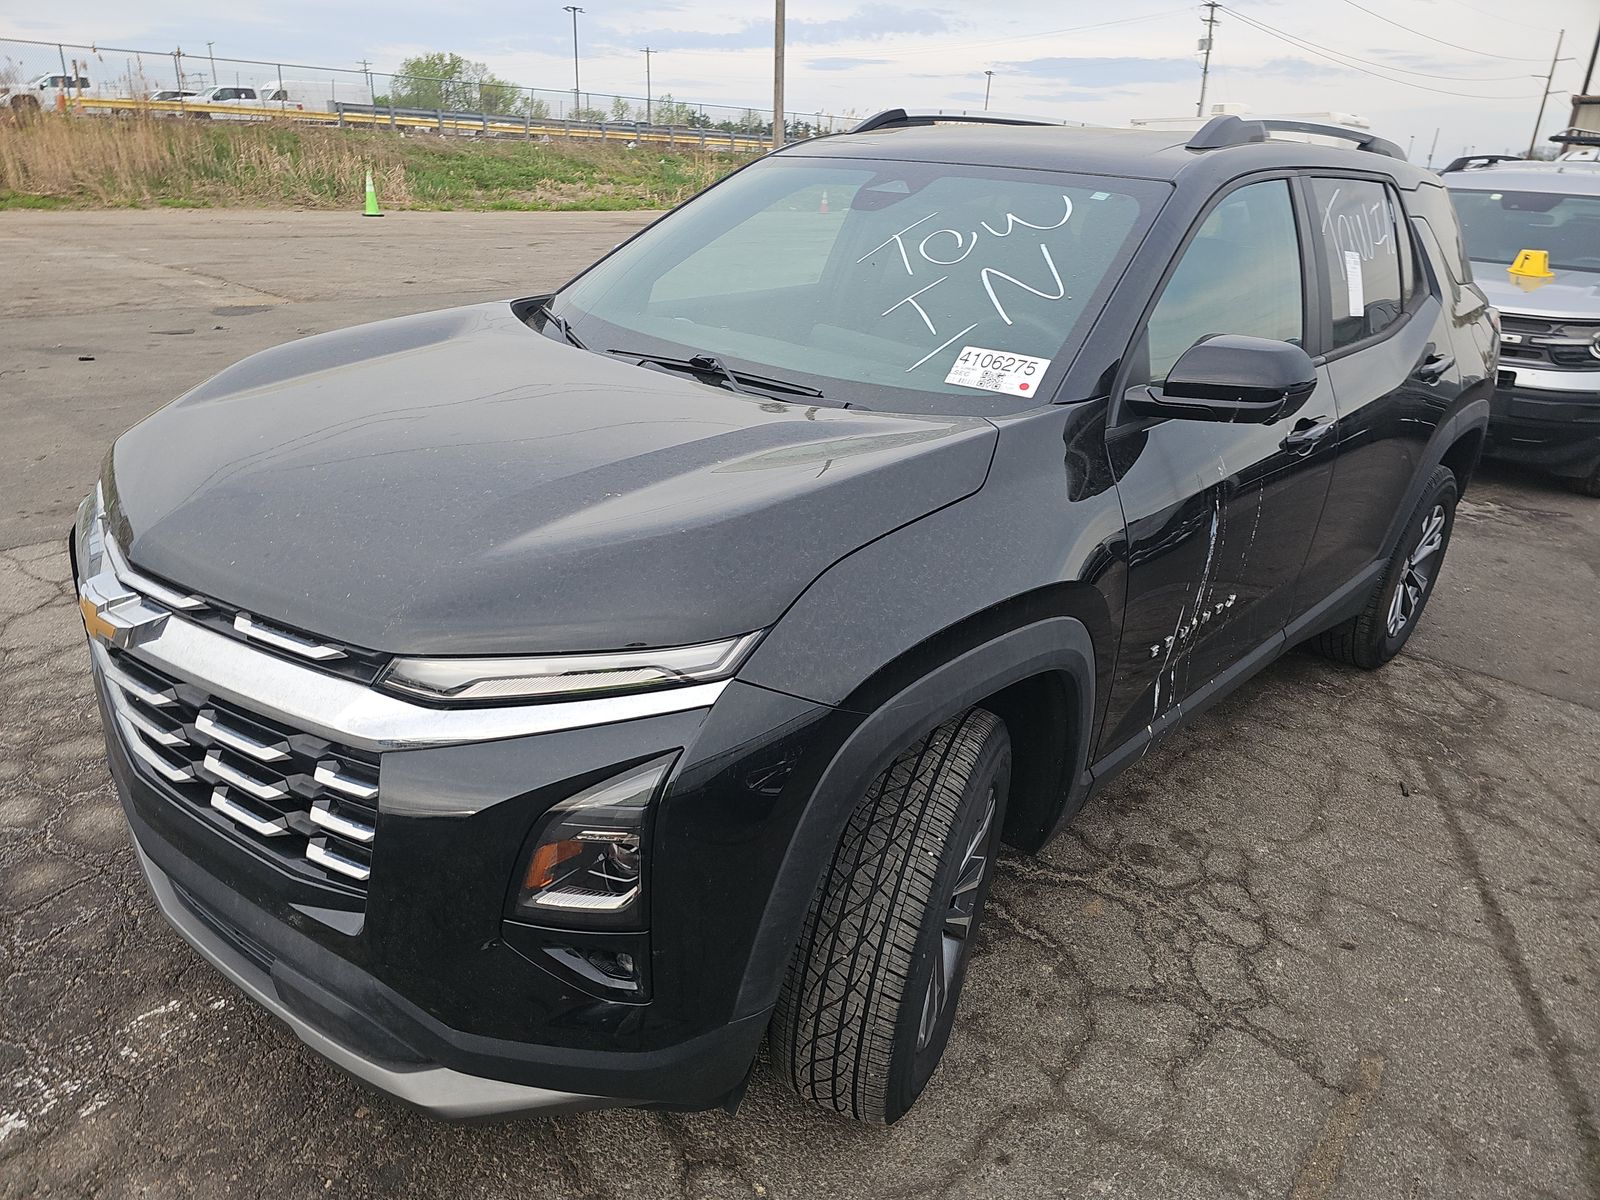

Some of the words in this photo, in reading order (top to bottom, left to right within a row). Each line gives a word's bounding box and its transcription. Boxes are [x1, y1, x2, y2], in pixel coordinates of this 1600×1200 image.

[856, 194, 1074, 276] TOW
[881, 244, 1065, 372] IN
[959, 351, 1039, 376] 4106275
